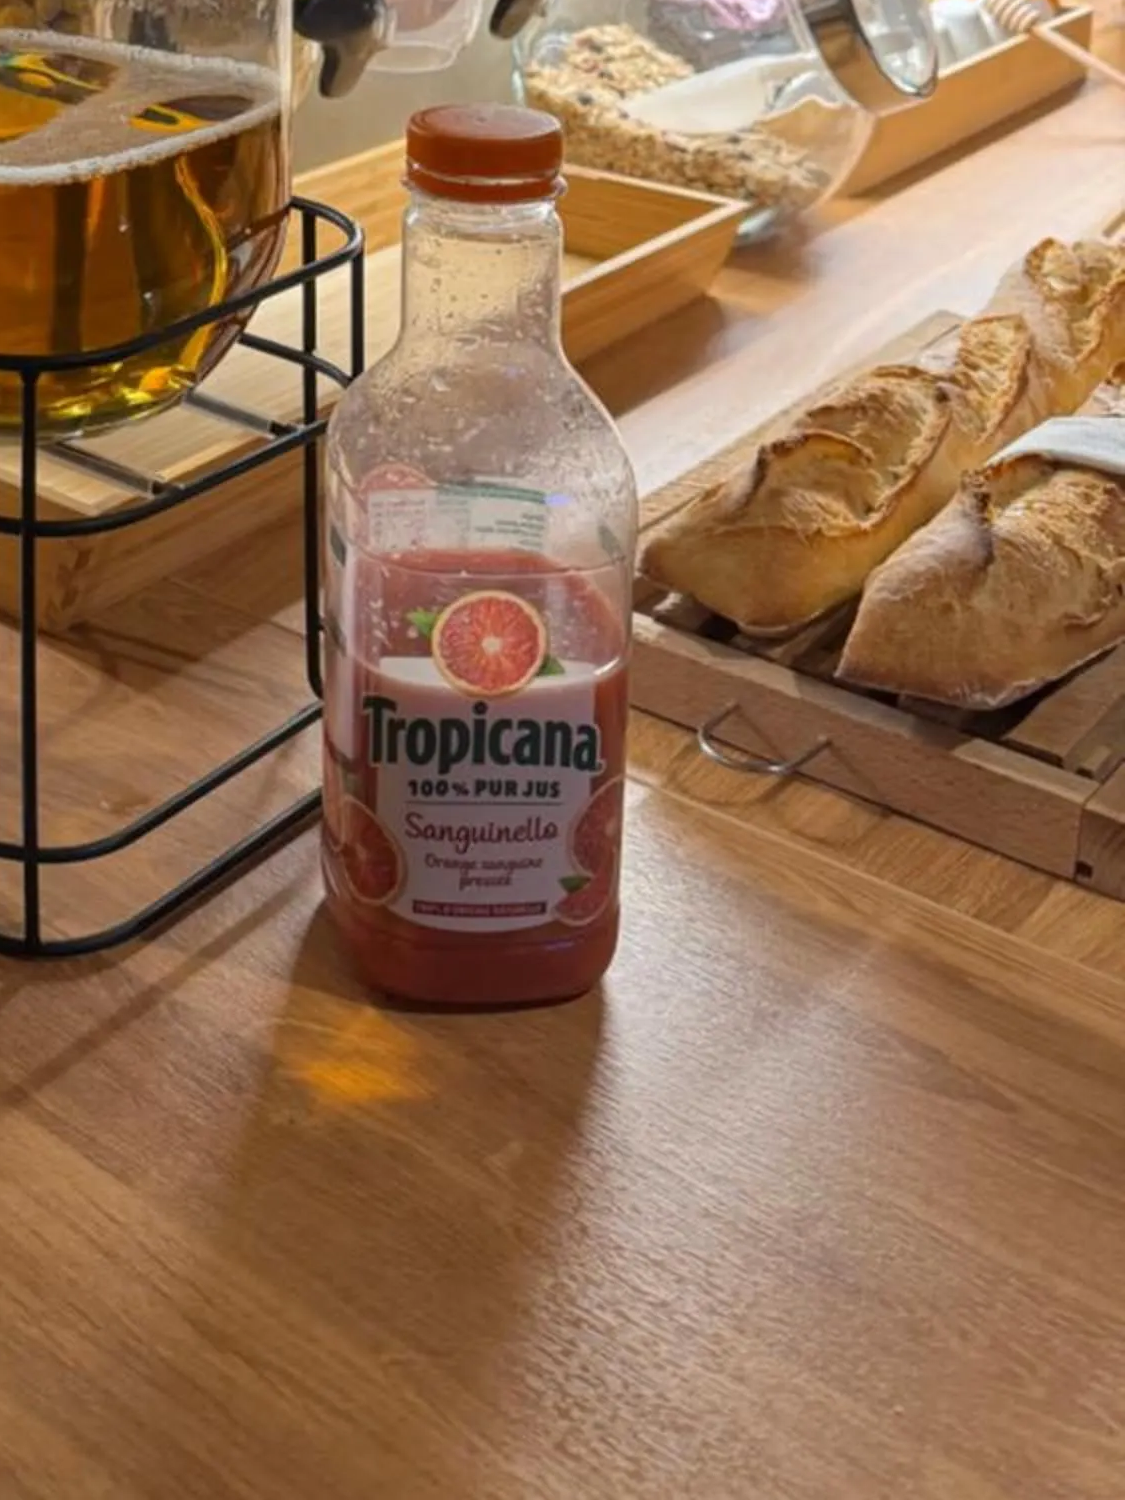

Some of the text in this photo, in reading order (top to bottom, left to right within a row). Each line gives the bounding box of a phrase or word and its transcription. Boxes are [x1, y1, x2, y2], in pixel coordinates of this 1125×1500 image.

[363, 695, 599, 775] Tropicana
[408, 779, 561, 798] 100% PUR JUS
[404, 811, 559, 855] Sanguinello
